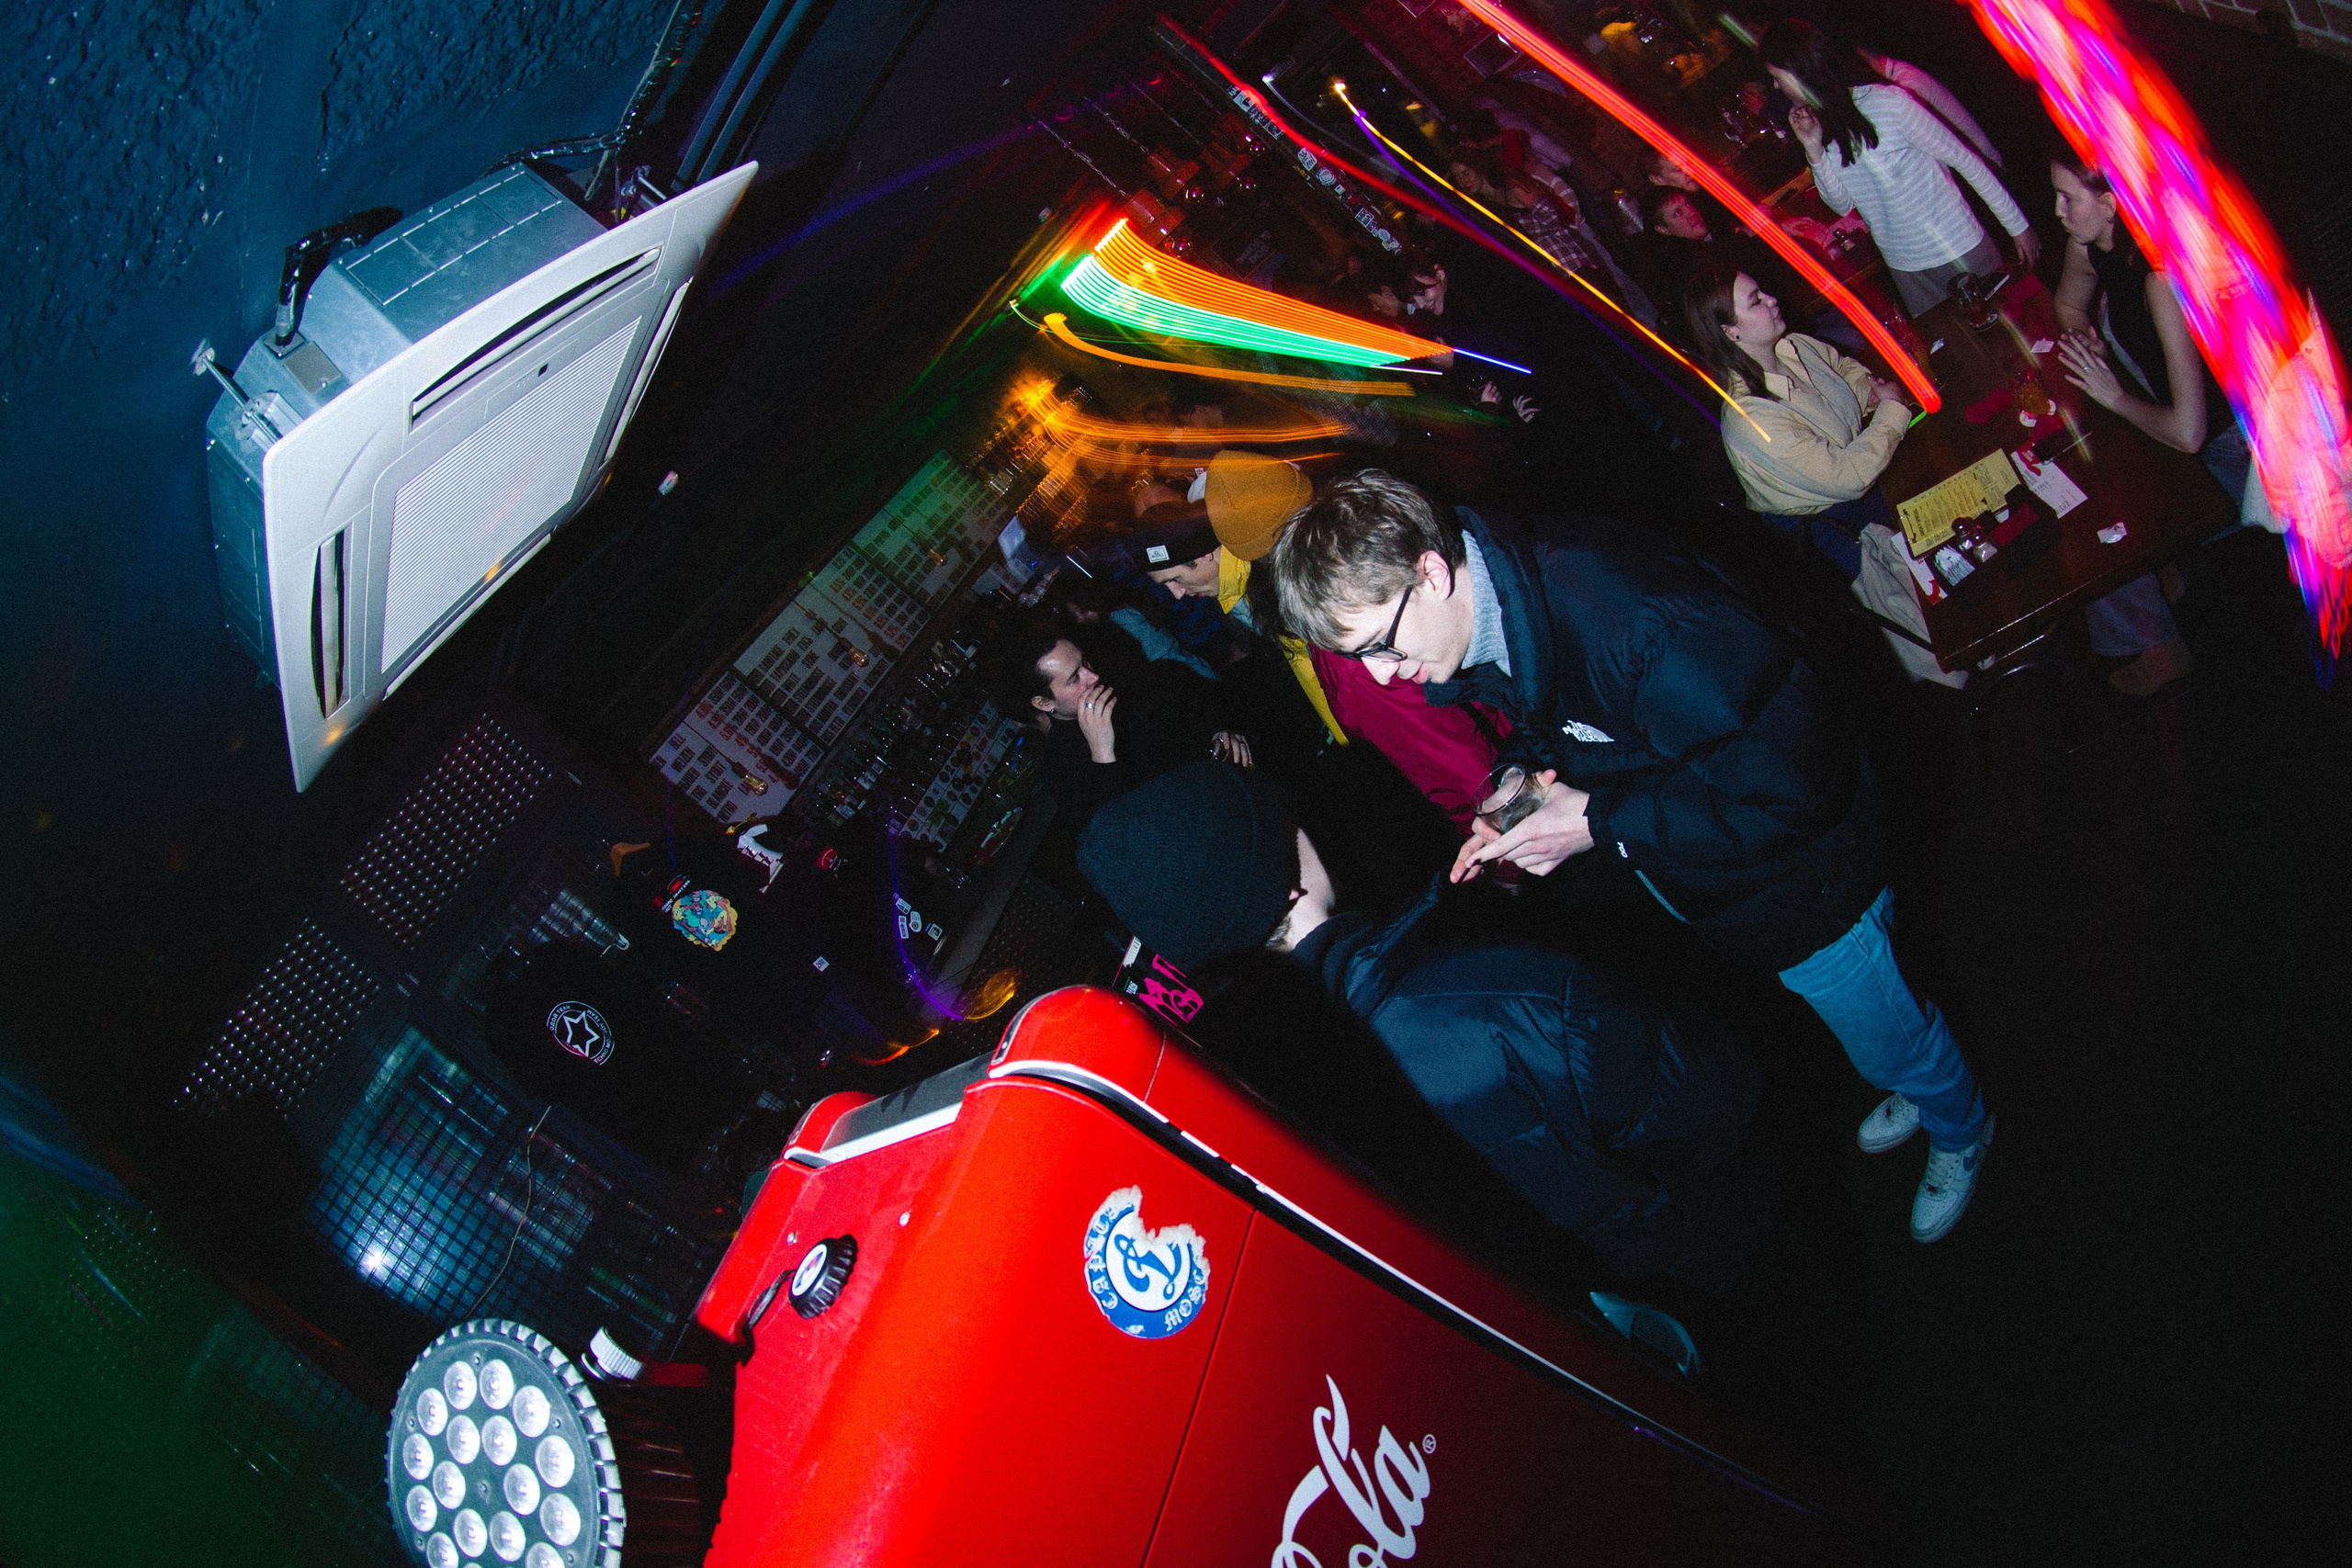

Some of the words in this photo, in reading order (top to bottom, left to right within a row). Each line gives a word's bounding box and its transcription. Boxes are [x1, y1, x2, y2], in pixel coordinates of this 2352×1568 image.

[670, 746, 695, 773] WEIZEN
[704, 760, 727, 784] STOUT
[705, 778, 733, 808] BLANCHE
